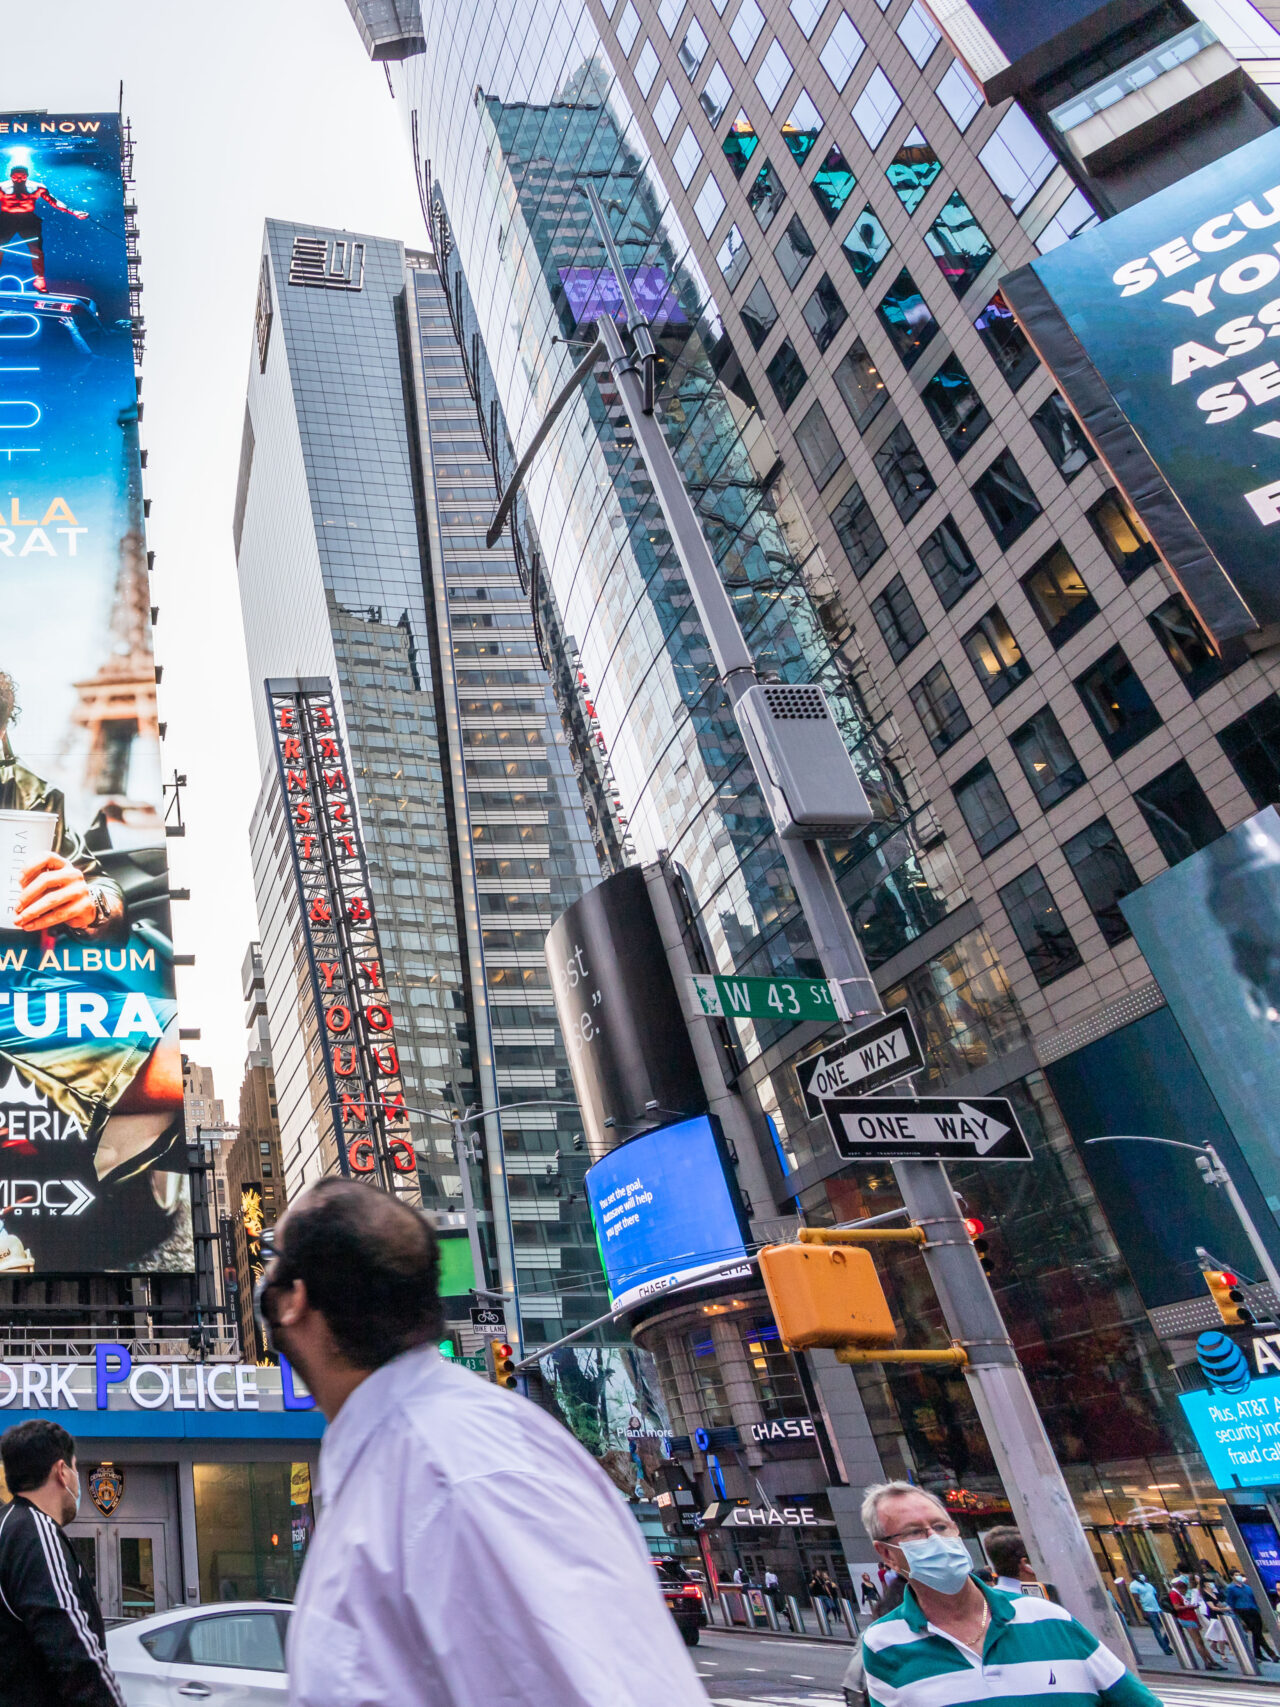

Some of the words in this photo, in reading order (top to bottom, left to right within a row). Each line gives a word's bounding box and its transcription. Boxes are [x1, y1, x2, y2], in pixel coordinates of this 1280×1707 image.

[40, 121, 101, 133] NOW
[1161, 241, 1280, 318] YO
[280, 707, 321, 859] ERNST
[320, 961, 375, 1173] YOUNG
[37, 948, 156, 972] ALBUM
[722, 980, 752, 1013] W
[767, 983, 802, 1015] 43
[809, 985, 832, 1005] St
[816, 1061, 850, 1095] ONE
[859, 1034, 900, 1073] WAY
[857, 1116, 917, 1140] ONE
[933, 1116, 991, 1141] WAY
[614, 1187, 626, 1200] the
[626, 1177, 644, 1197] goal,
[623, 1197, 636, 1211] will
[635, 1190, 654, 1206] help
[622, 1213, 640, 1228] there
[224, 1223, 233, 1265] TIMES
[474, 1325, 489, 1333] BIKE
[490, 1325, 506, 1333] LANE
[95, 1342, 260, 1410] POLICE
[1208, 1405, 1238, 1424] Plus,
[1237, 1397, 1270, 1420] AT&T
[616, 1427, 644, 1438] Plant
[646, 1429, 673, 1438] more
[750, 1419, 815, 1441] CHASE
[1216, 1421, 1262, 1444] security
[1228, 1444, 1263, 1465] fraud
[733, 1507, 819, 1526] CHASE
